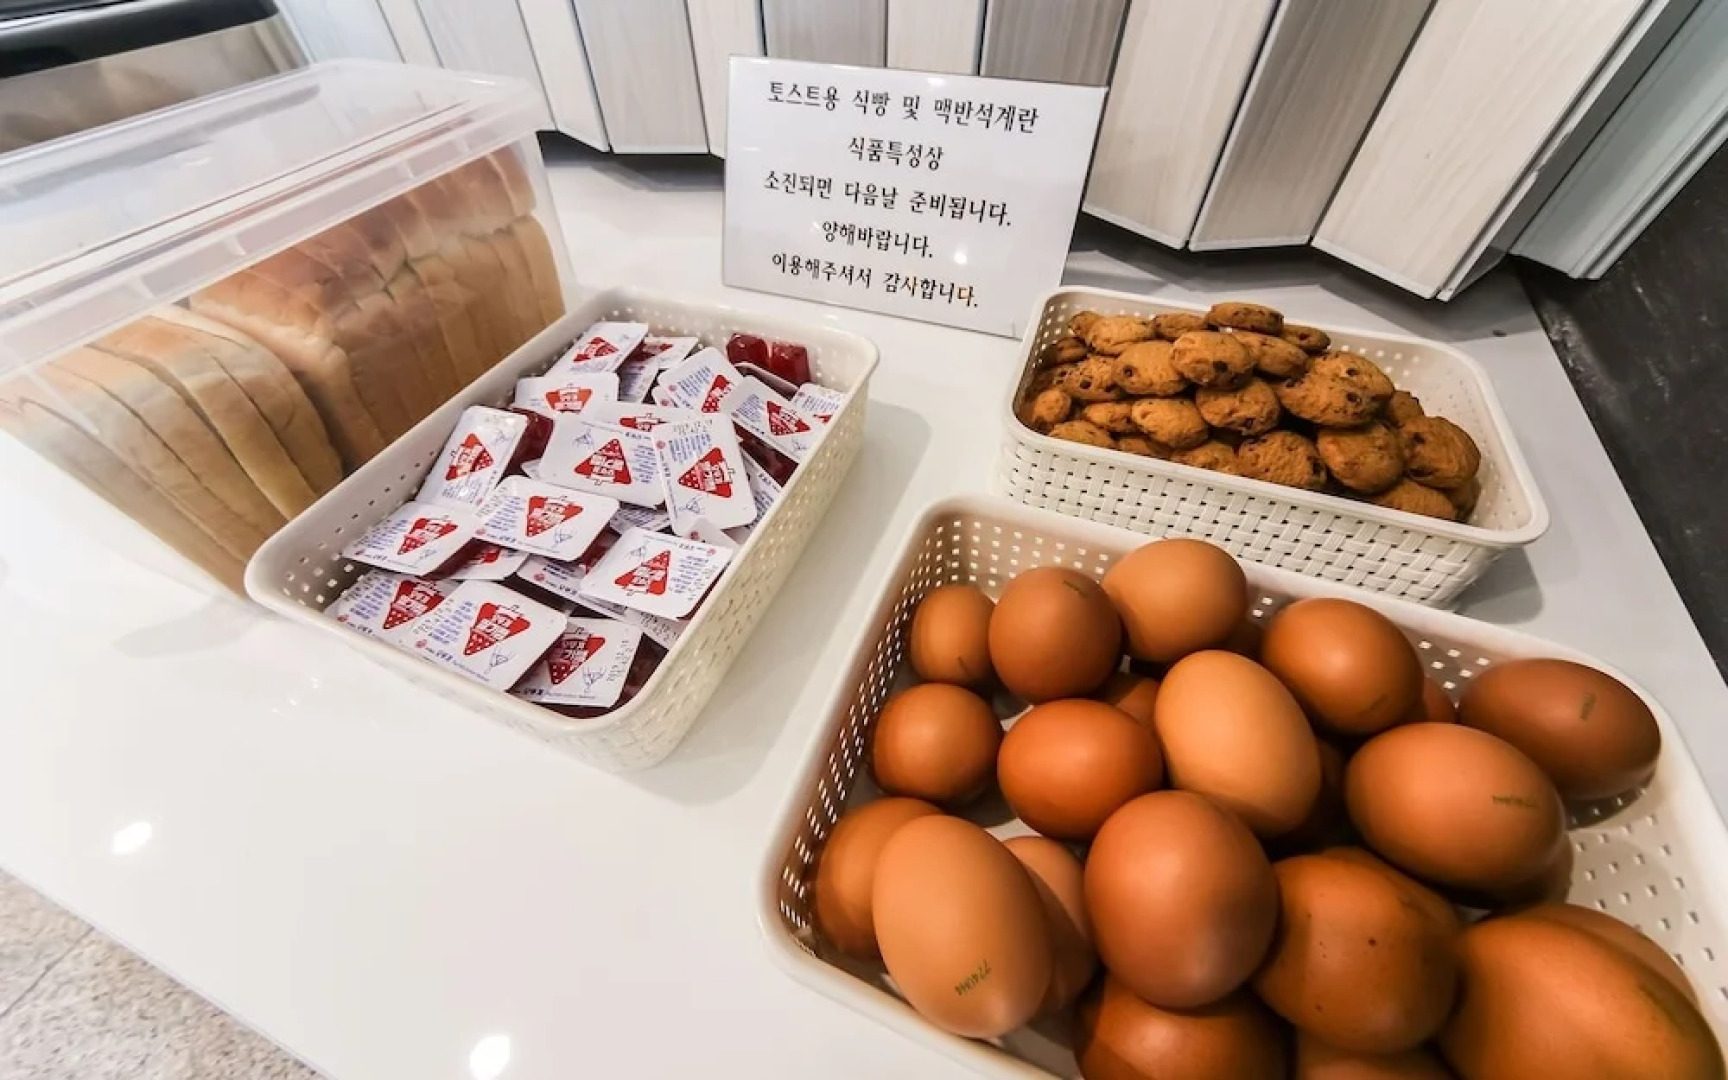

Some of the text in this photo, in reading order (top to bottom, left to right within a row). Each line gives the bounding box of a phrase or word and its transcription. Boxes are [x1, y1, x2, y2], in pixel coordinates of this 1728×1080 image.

[767, 80, 1039, 134] 토스트용 식빵 및 맥반석계란
[848, 136, 944, 171] 식품특성상
[763, 171, 1012, 226] 소진되면 다음날 준비됩니다.
[822, 221, 933, 258] 양해바랍니다.
[772, 253, 978, 308] 이용해주셔서 감사합니다.
